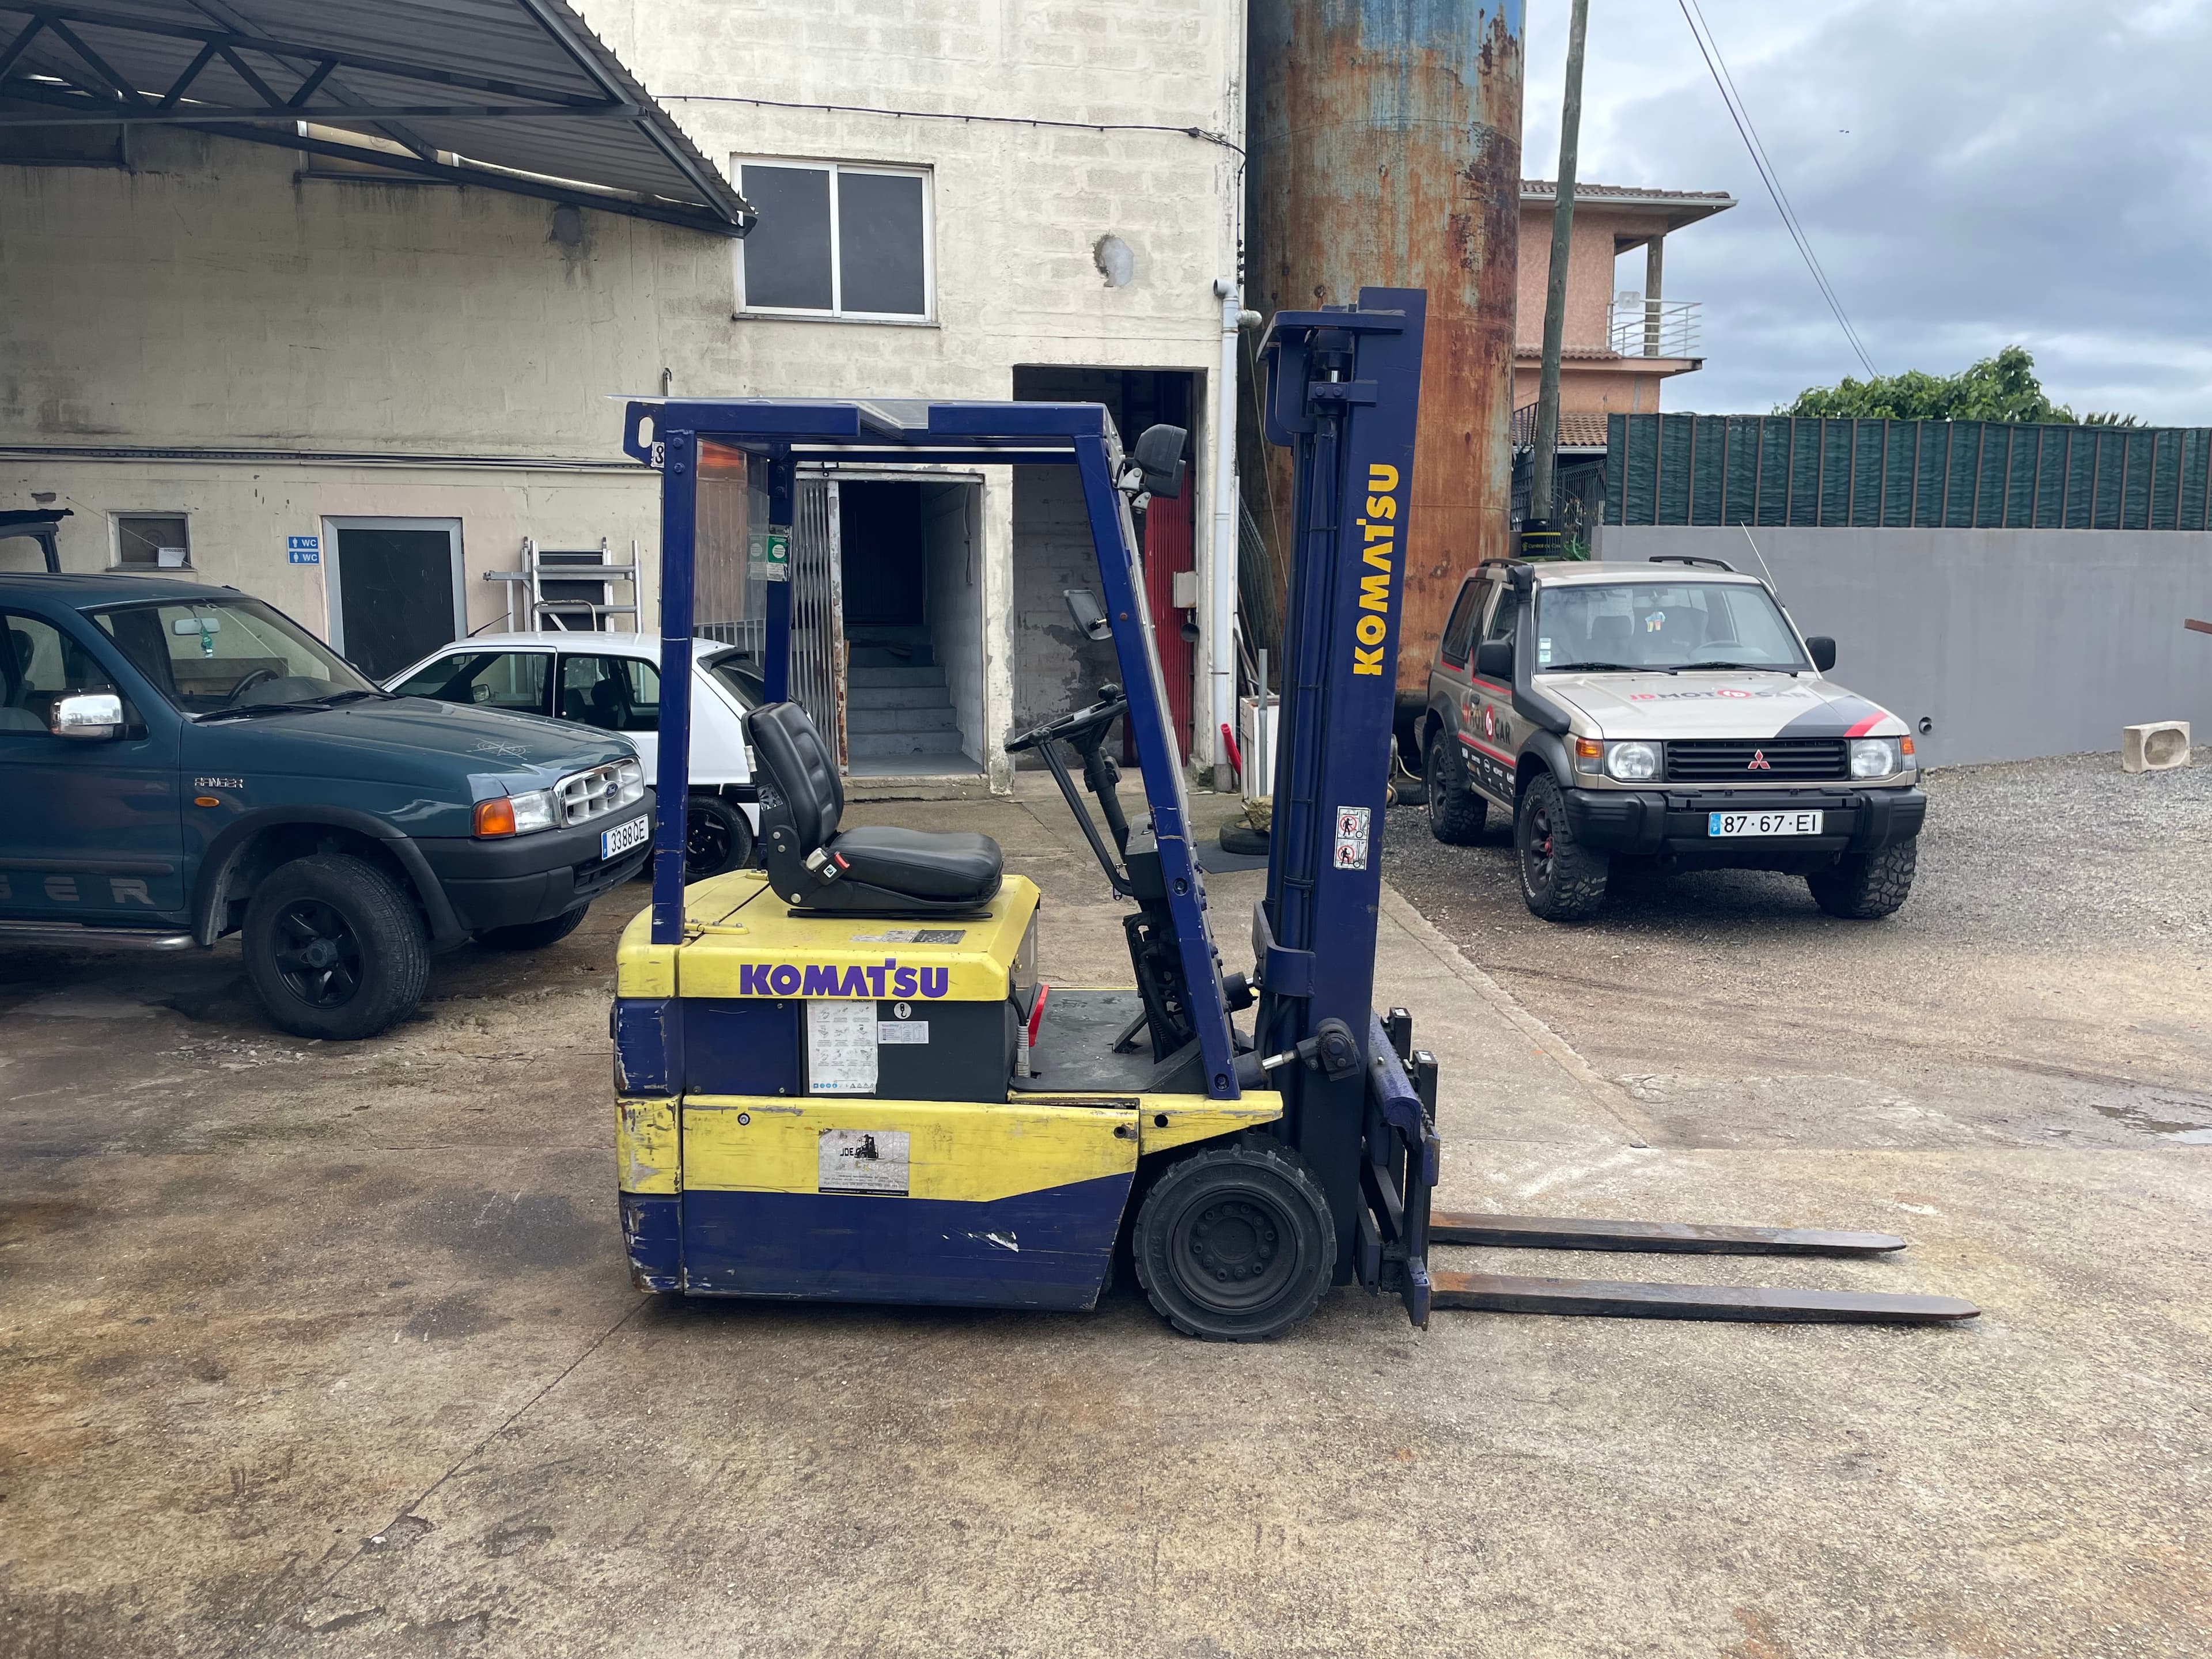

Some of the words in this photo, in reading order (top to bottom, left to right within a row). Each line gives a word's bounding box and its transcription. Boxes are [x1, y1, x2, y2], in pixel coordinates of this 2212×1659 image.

[1353, 463, 1399, 675] KOMATSU
[195, 777, 243, 788] RANGER
[740, 958, 949, 998] KOMATSU
